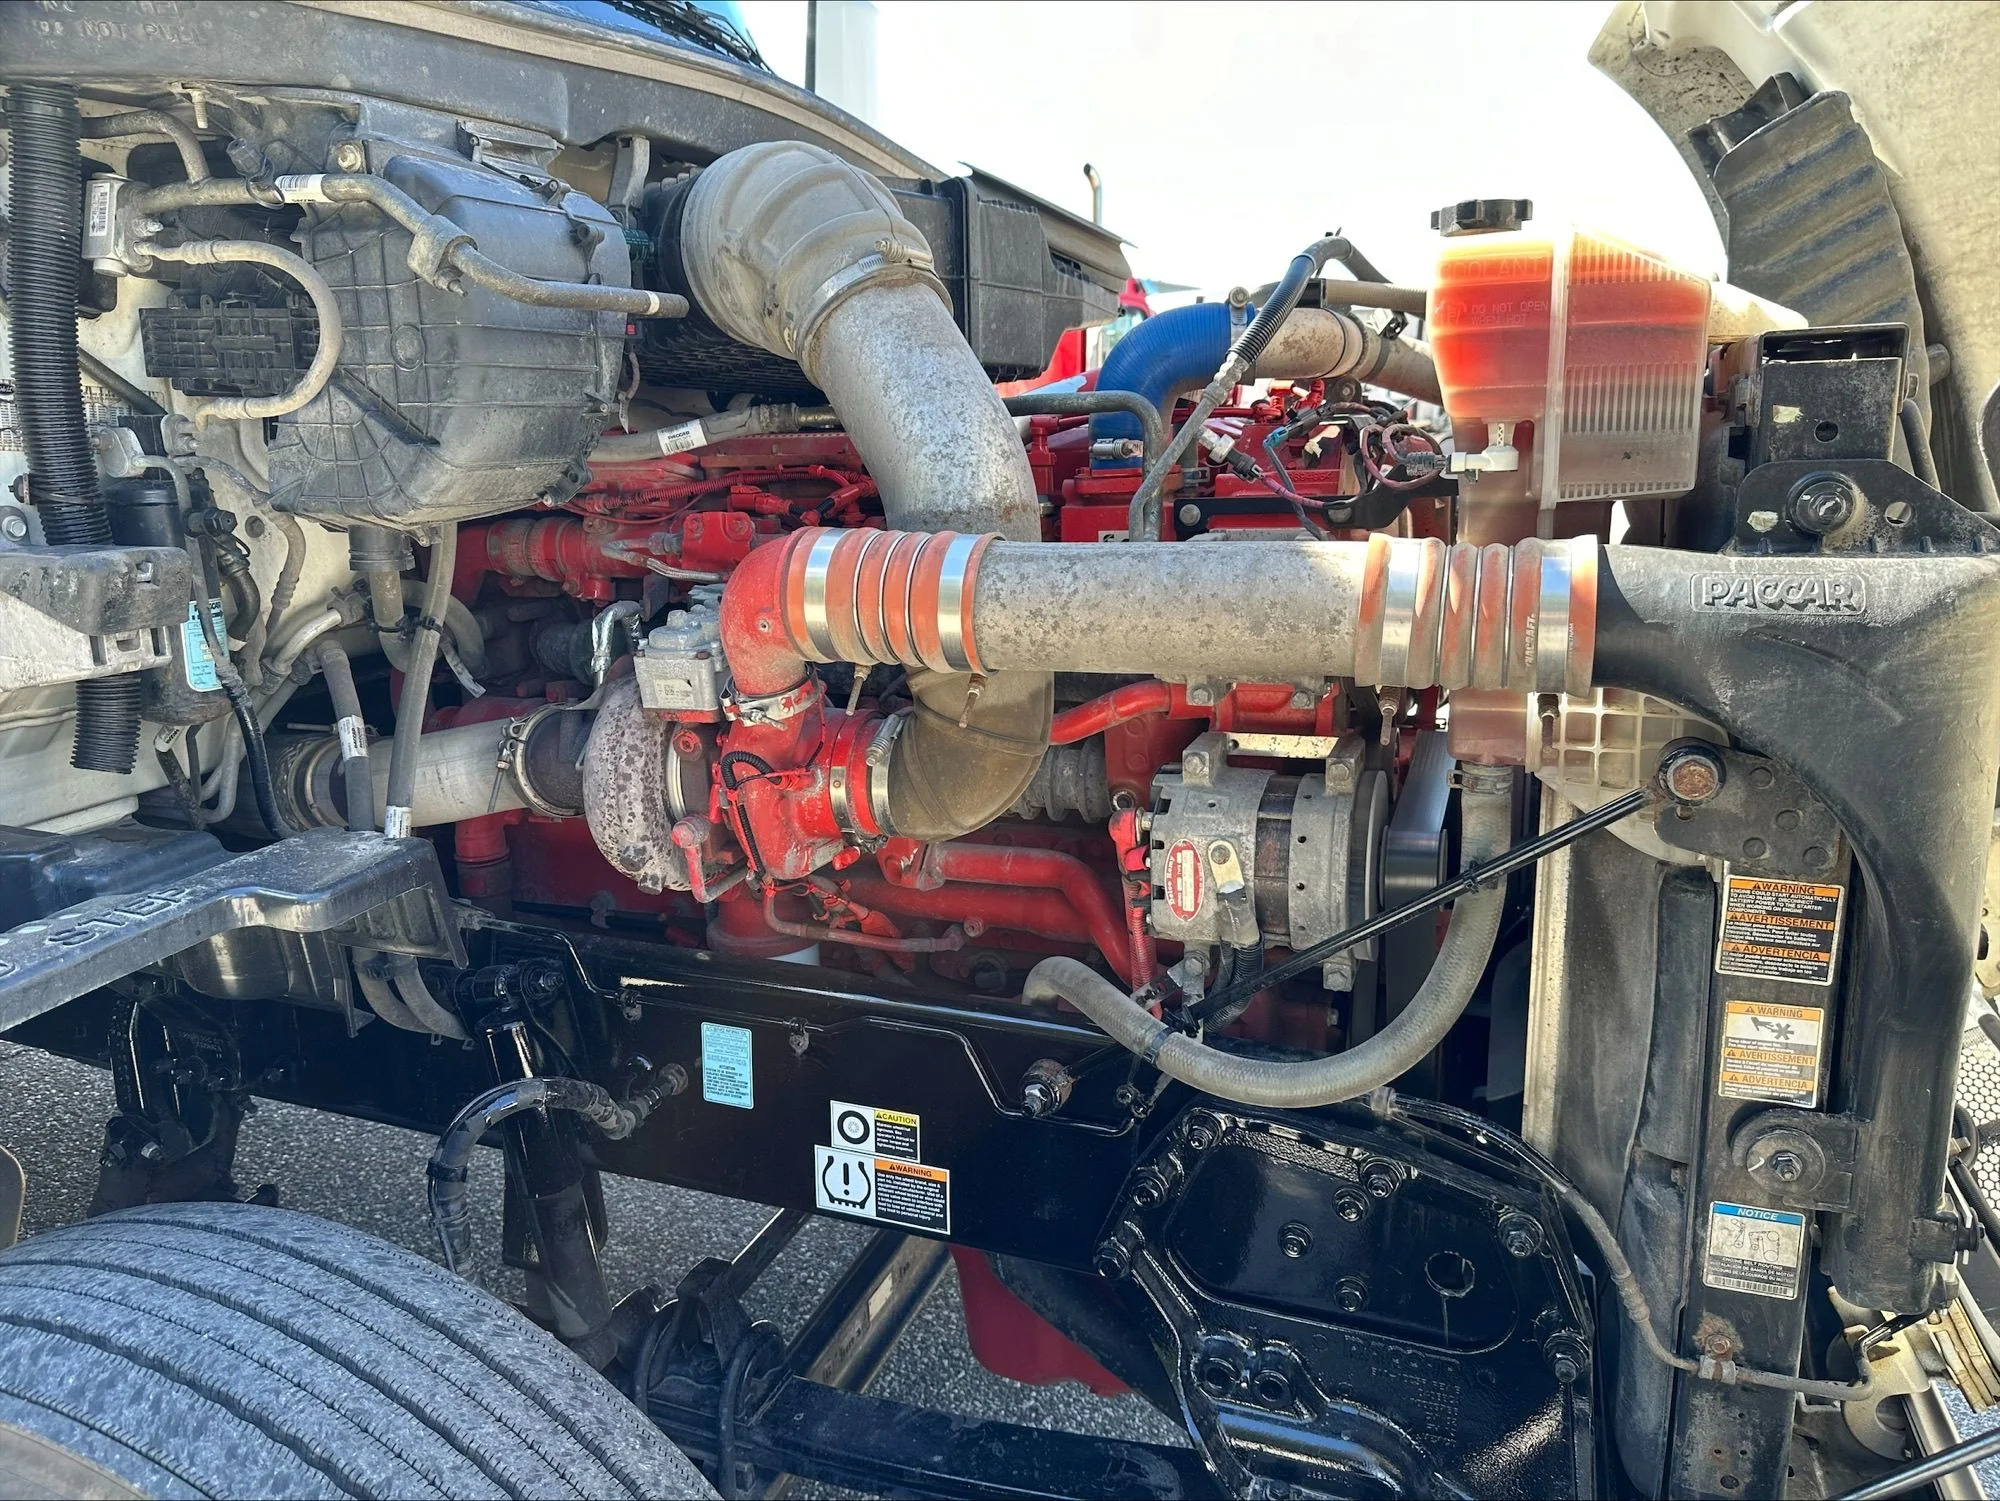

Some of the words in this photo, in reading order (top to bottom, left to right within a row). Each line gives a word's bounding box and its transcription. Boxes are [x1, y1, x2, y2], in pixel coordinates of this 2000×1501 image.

[1492, 302, 1514, 313] NOT
[1519, 300, 1548, 312] OPEN
[1703, 577, 1858, 611] PACCAR
[1167, 856, 1176, 879] Remy
[1167, 880, 1176, 905] Delco
[1762, 883, 1816, 894] WARNING
[48, 887, 188, 946] STEP
[1739, 913, 1831, 929] AVERTISSEMENT
[1743, 946, 1821, 960] ADVERTENCIA
[1758, 1007, 1803, 1018] WARNING
[1739, 1050, 1813, 1065] AVERTISSEMENT
[1742, 1075, 1808, 1090] ADVERTENCIA
[882, 1113, 916, 1124] CAUTION
[896, 1165, 932, 1177] WARNING
[1737, 1208, 1778, 1221] NOTICE
